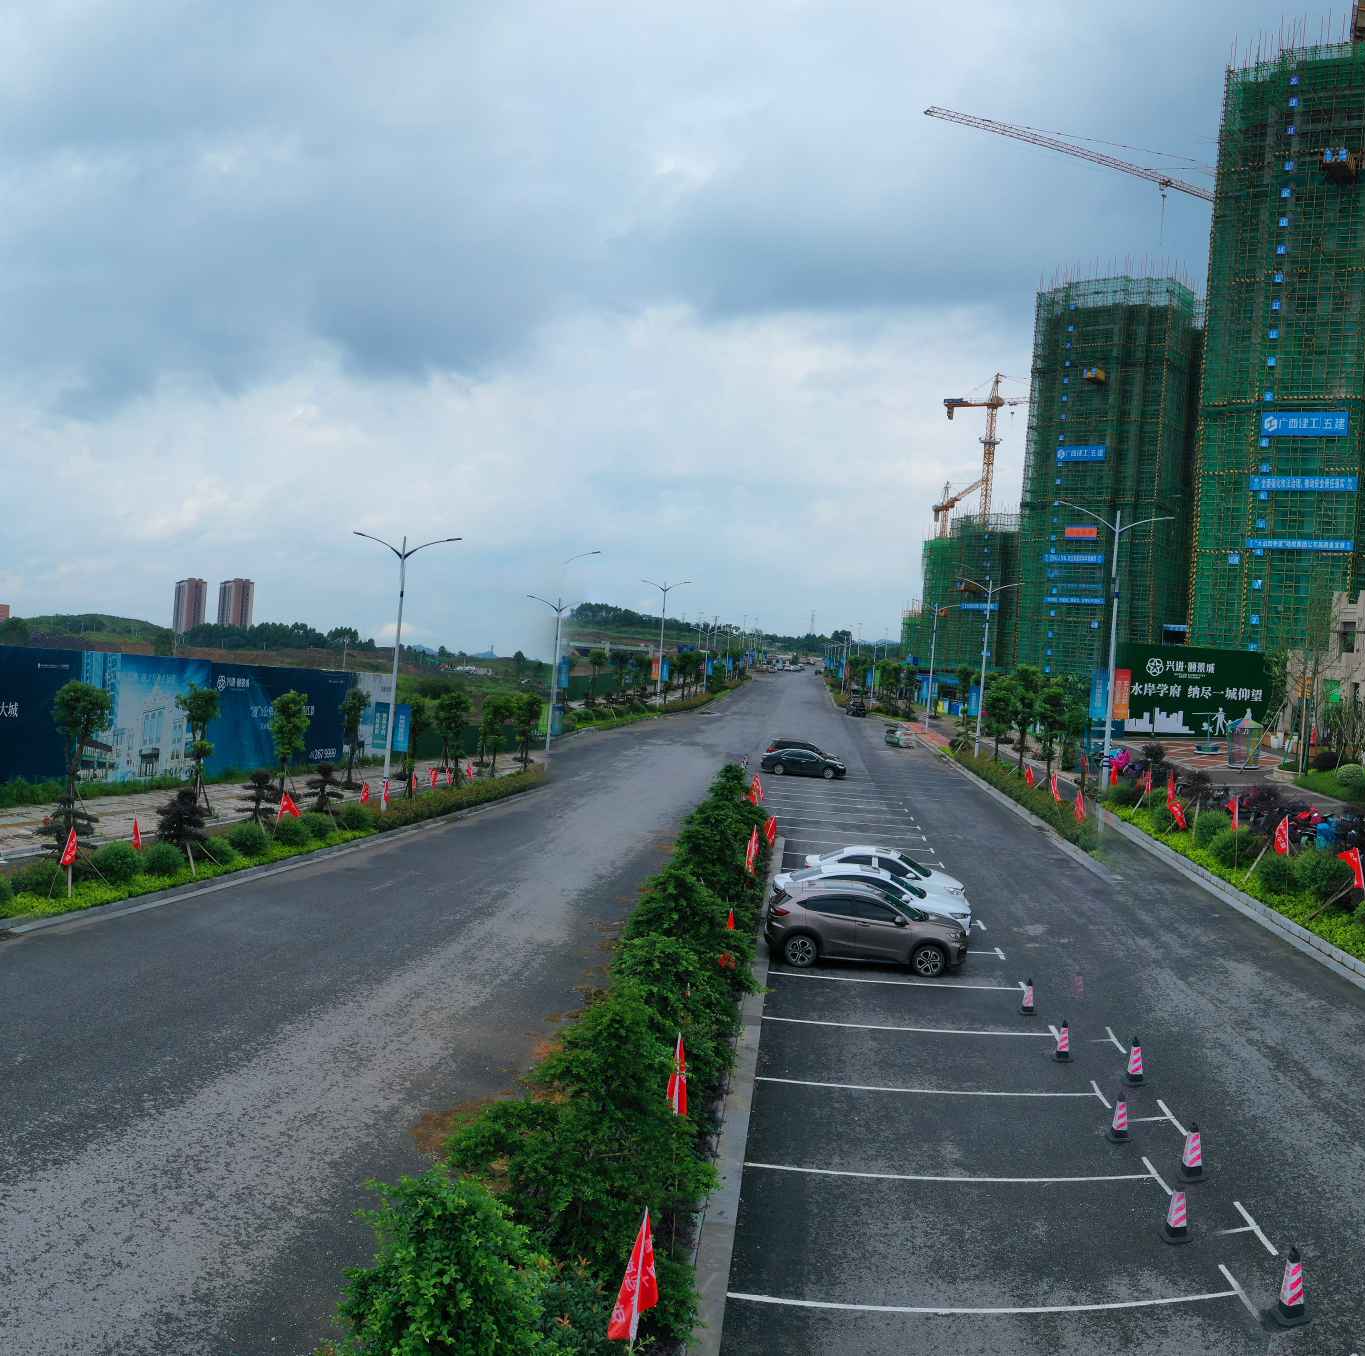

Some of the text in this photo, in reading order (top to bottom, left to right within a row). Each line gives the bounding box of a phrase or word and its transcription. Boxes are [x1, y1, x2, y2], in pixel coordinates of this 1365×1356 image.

[1131, 682, 1182, 698] 水岸学府
[1187, 685, 1263, 702] 纳尽一城仰望
